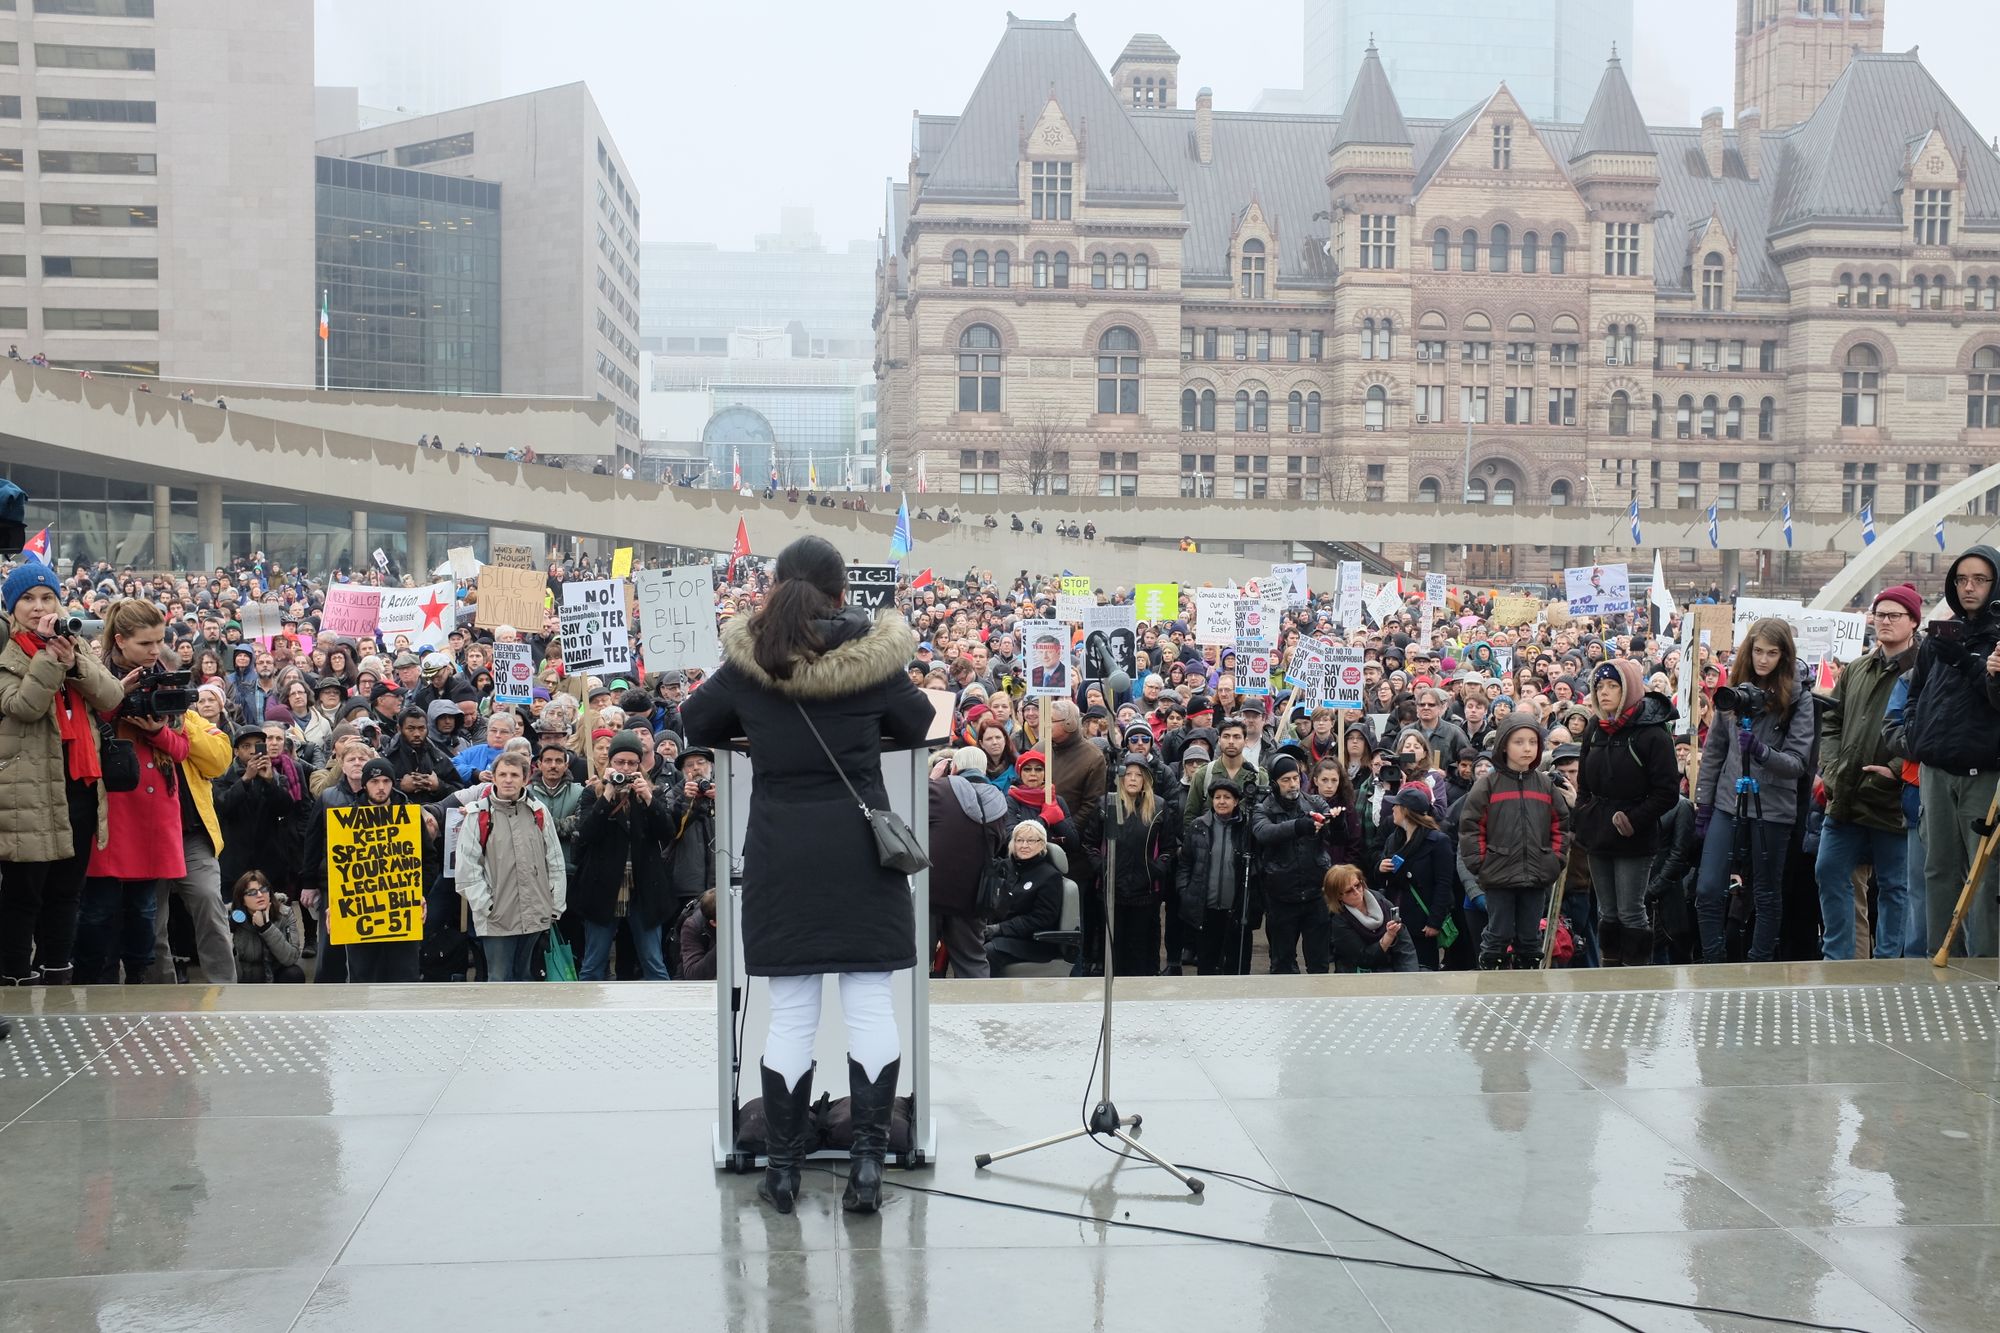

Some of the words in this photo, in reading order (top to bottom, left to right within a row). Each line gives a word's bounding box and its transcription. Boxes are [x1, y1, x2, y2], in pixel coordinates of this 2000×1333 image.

[496, 554, 531, 562] THOUGHT
[482, 568, 516, 588] BILL
[866, 570, 892, 582] C-51
[1064, 578, 1088, 587] STOP
[496, 589, 523, 598] IS
[585, 584, 616, 605] NO!
[644, 578, 706, 603] STOP
[350, 594, 366, 606] BILL
[388, 595, 418, 608] Action
[844, 590, 885, 606] NEW
[1523, 600, 1536, 608] BE
[1580, 595, 1592, 604] TO
[1570, 604, 1598, 614] SECRET
[1604, 601, 1629, 611] POLICE
[389, 614, 415, 623] Socialiste
[560, 612, 600, 622] Islamophobia
[655, 606, 696, 628] BILL
[1207, 617, 1232, 626] Middle
[1235, 612, 1246, 620] SAY
[327, 617, 358, 632] SECURITY
[562, 623, 580, 636] SAY
[1236, 620, 1245, 628] NO
[1836, 620, 1862, 640] BILL
[1246, 628, 1260, 636] WAR
[563, 636, 577, 649] NO
[579, 634, 592, 648] TO
[649, 630, 695, 654] C-51
[494, 643, 514, 652] DEFEND
[515, 645, 529, 653] CIVIL
[1295, 648, 1309, 660] SAY
[494, 652, 520, 660] LIBERTIES
[564, 648, 591, 663] WAR!
[1236, 654, 1251, 665] SAY
[1325, 655, 1362, 663] ISLAMOPHOBIA
[495, 660, 510, 671] SAY
[1292, 658, 1303, 669] NO
[1236, 666, 1248, 676] NO
[1289, 667, 1298, 678] TO
[1324, 664, 1341, 676] SAY
[496, 672, 507, 683] NO
[1236, 676, 1246, 686] TO
[1249, 677, 1266, 688] WAR
[1307, 677, 1320, 688] SAY
[1324, 676, 1337, 688] NO
[496, 683, 507, 695] TO
[510, 684, 529, 696] WAR
[1306, 688, 1316, 698] NO
[1324, 688, 1336, 700] TO
[1338, 688, 1360, 700] WAR
[1306, 698, 1315, 709] TO
[333, 805, 410, 829] WANNA
[353, 826, 399, 846] KEEP
[336, 859, 389, 882] YOUR
[341, 871, 420, 896] LEGALLY?
[356, 910, 411, 936] C-51
